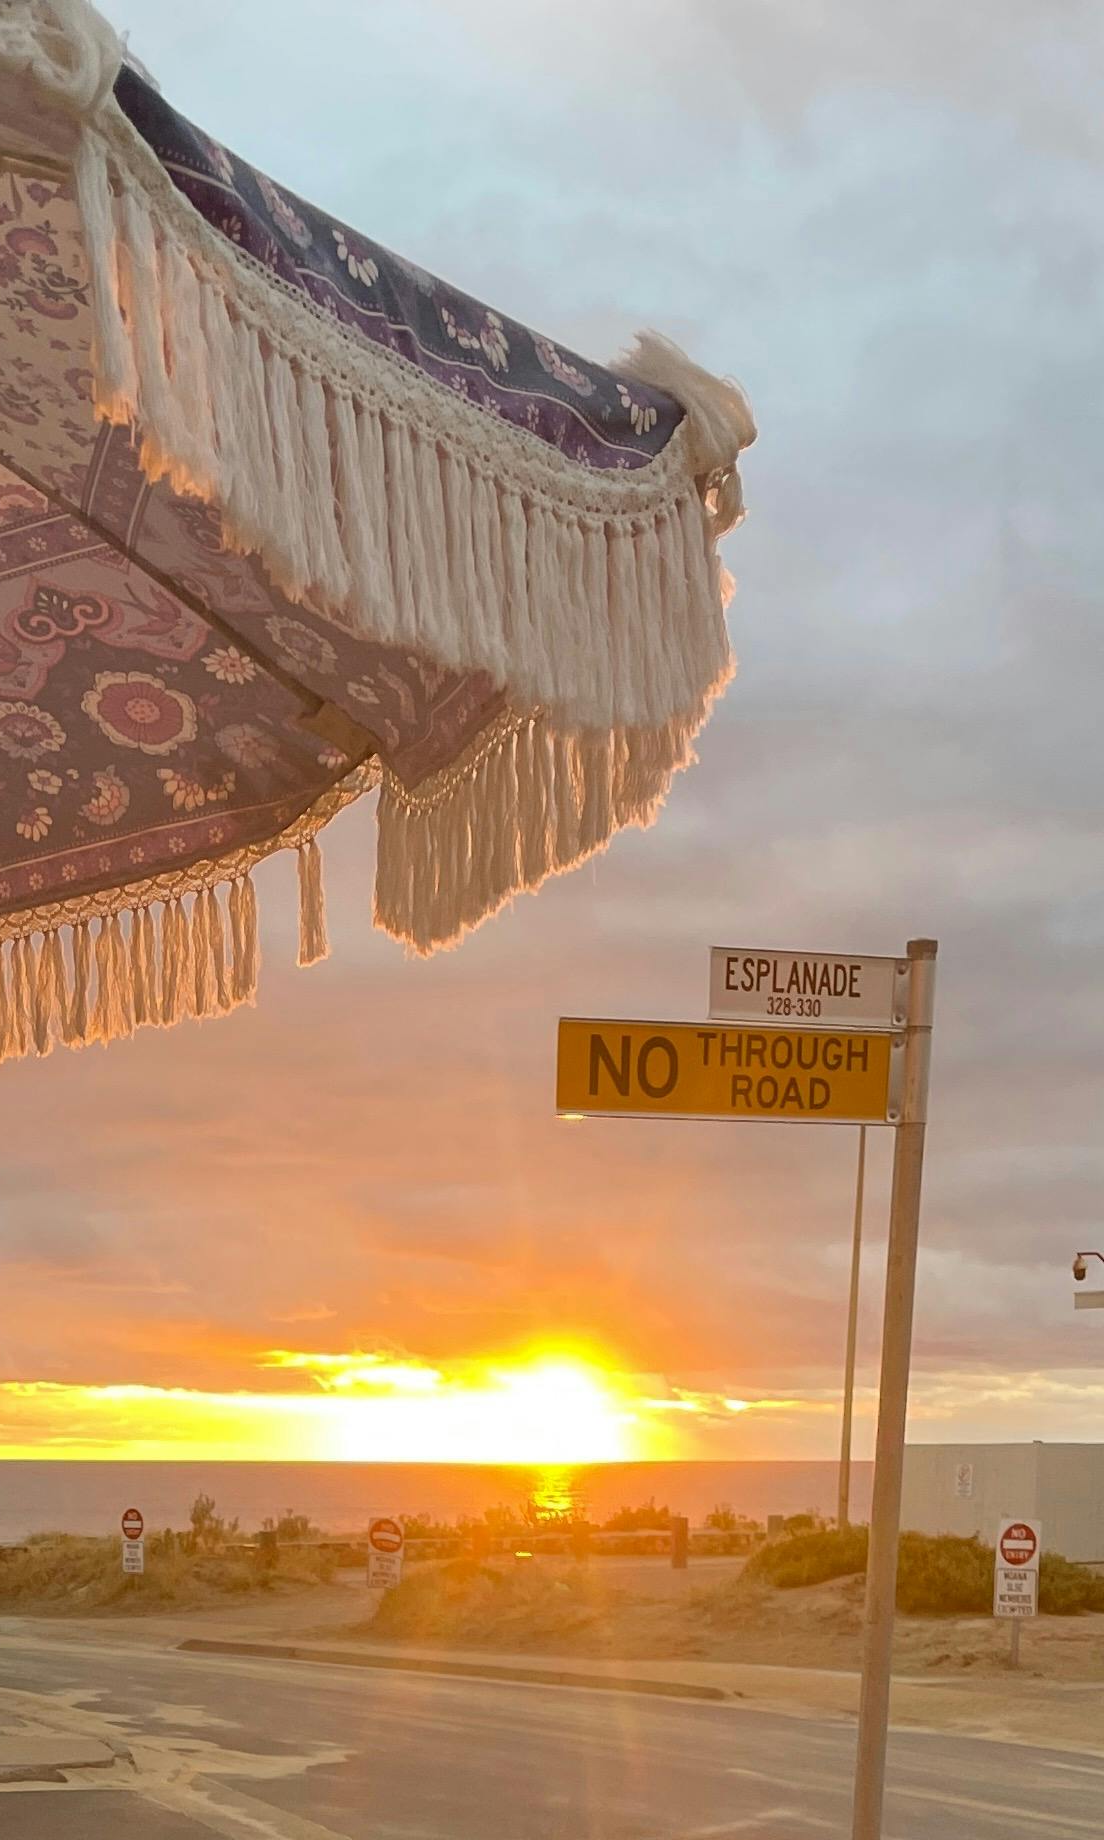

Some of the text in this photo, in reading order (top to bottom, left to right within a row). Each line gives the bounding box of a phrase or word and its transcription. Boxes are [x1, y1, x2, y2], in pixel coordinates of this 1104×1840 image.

[725, 956, 862, 998] ESPLANADE
[766, 996, 822, 1018] 328-330
[588, 1033, 679, 1098] NO
[696, 1031, 869, 1072] THROUGH
[730, 1074, 831, 1110] ROAD
[1011, 1528, 1027, 1539] NO
